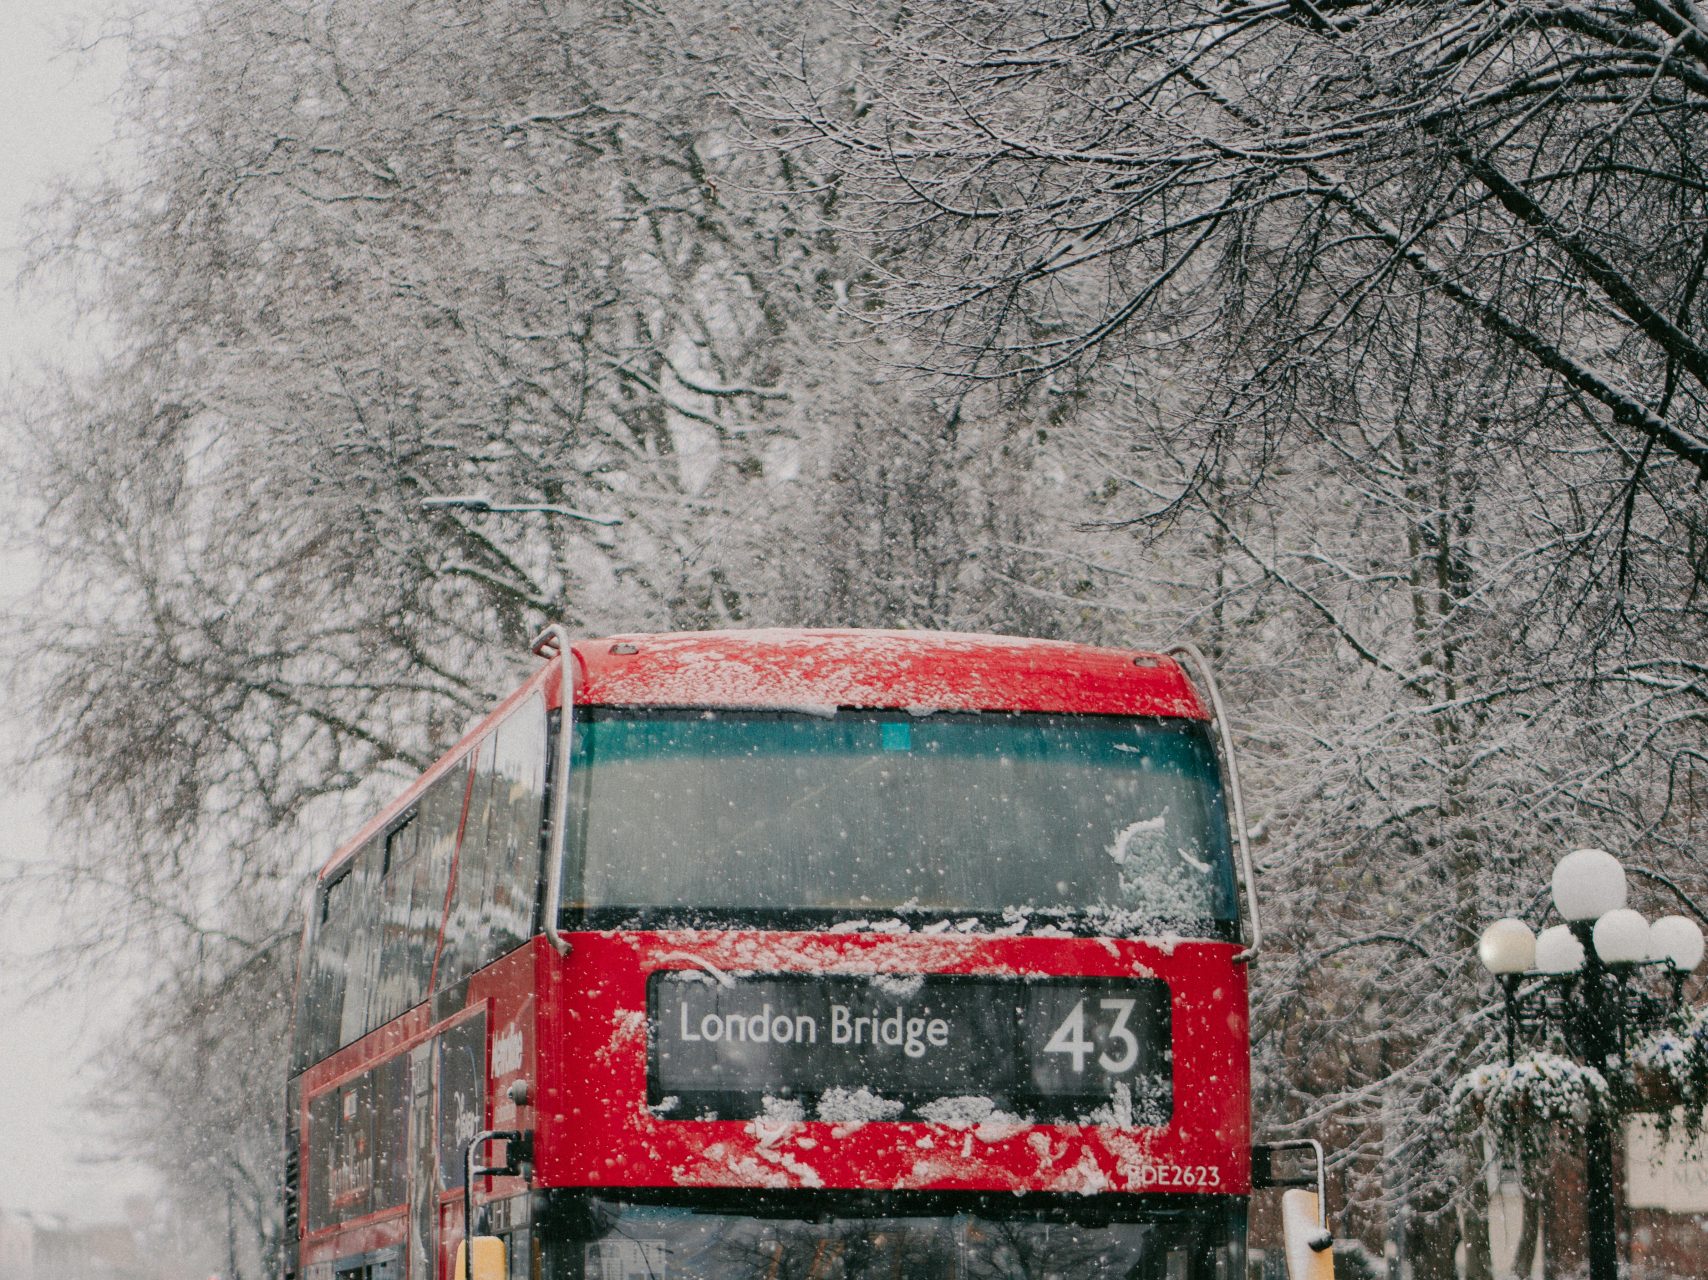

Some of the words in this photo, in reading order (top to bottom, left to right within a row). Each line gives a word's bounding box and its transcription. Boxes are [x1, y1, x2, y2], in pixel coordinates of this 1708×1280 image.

[681, 1002, 816, 1043] London
[831, 1004, 949, 1058] Bridge
[1043, 999, 1139, 1073] 43
